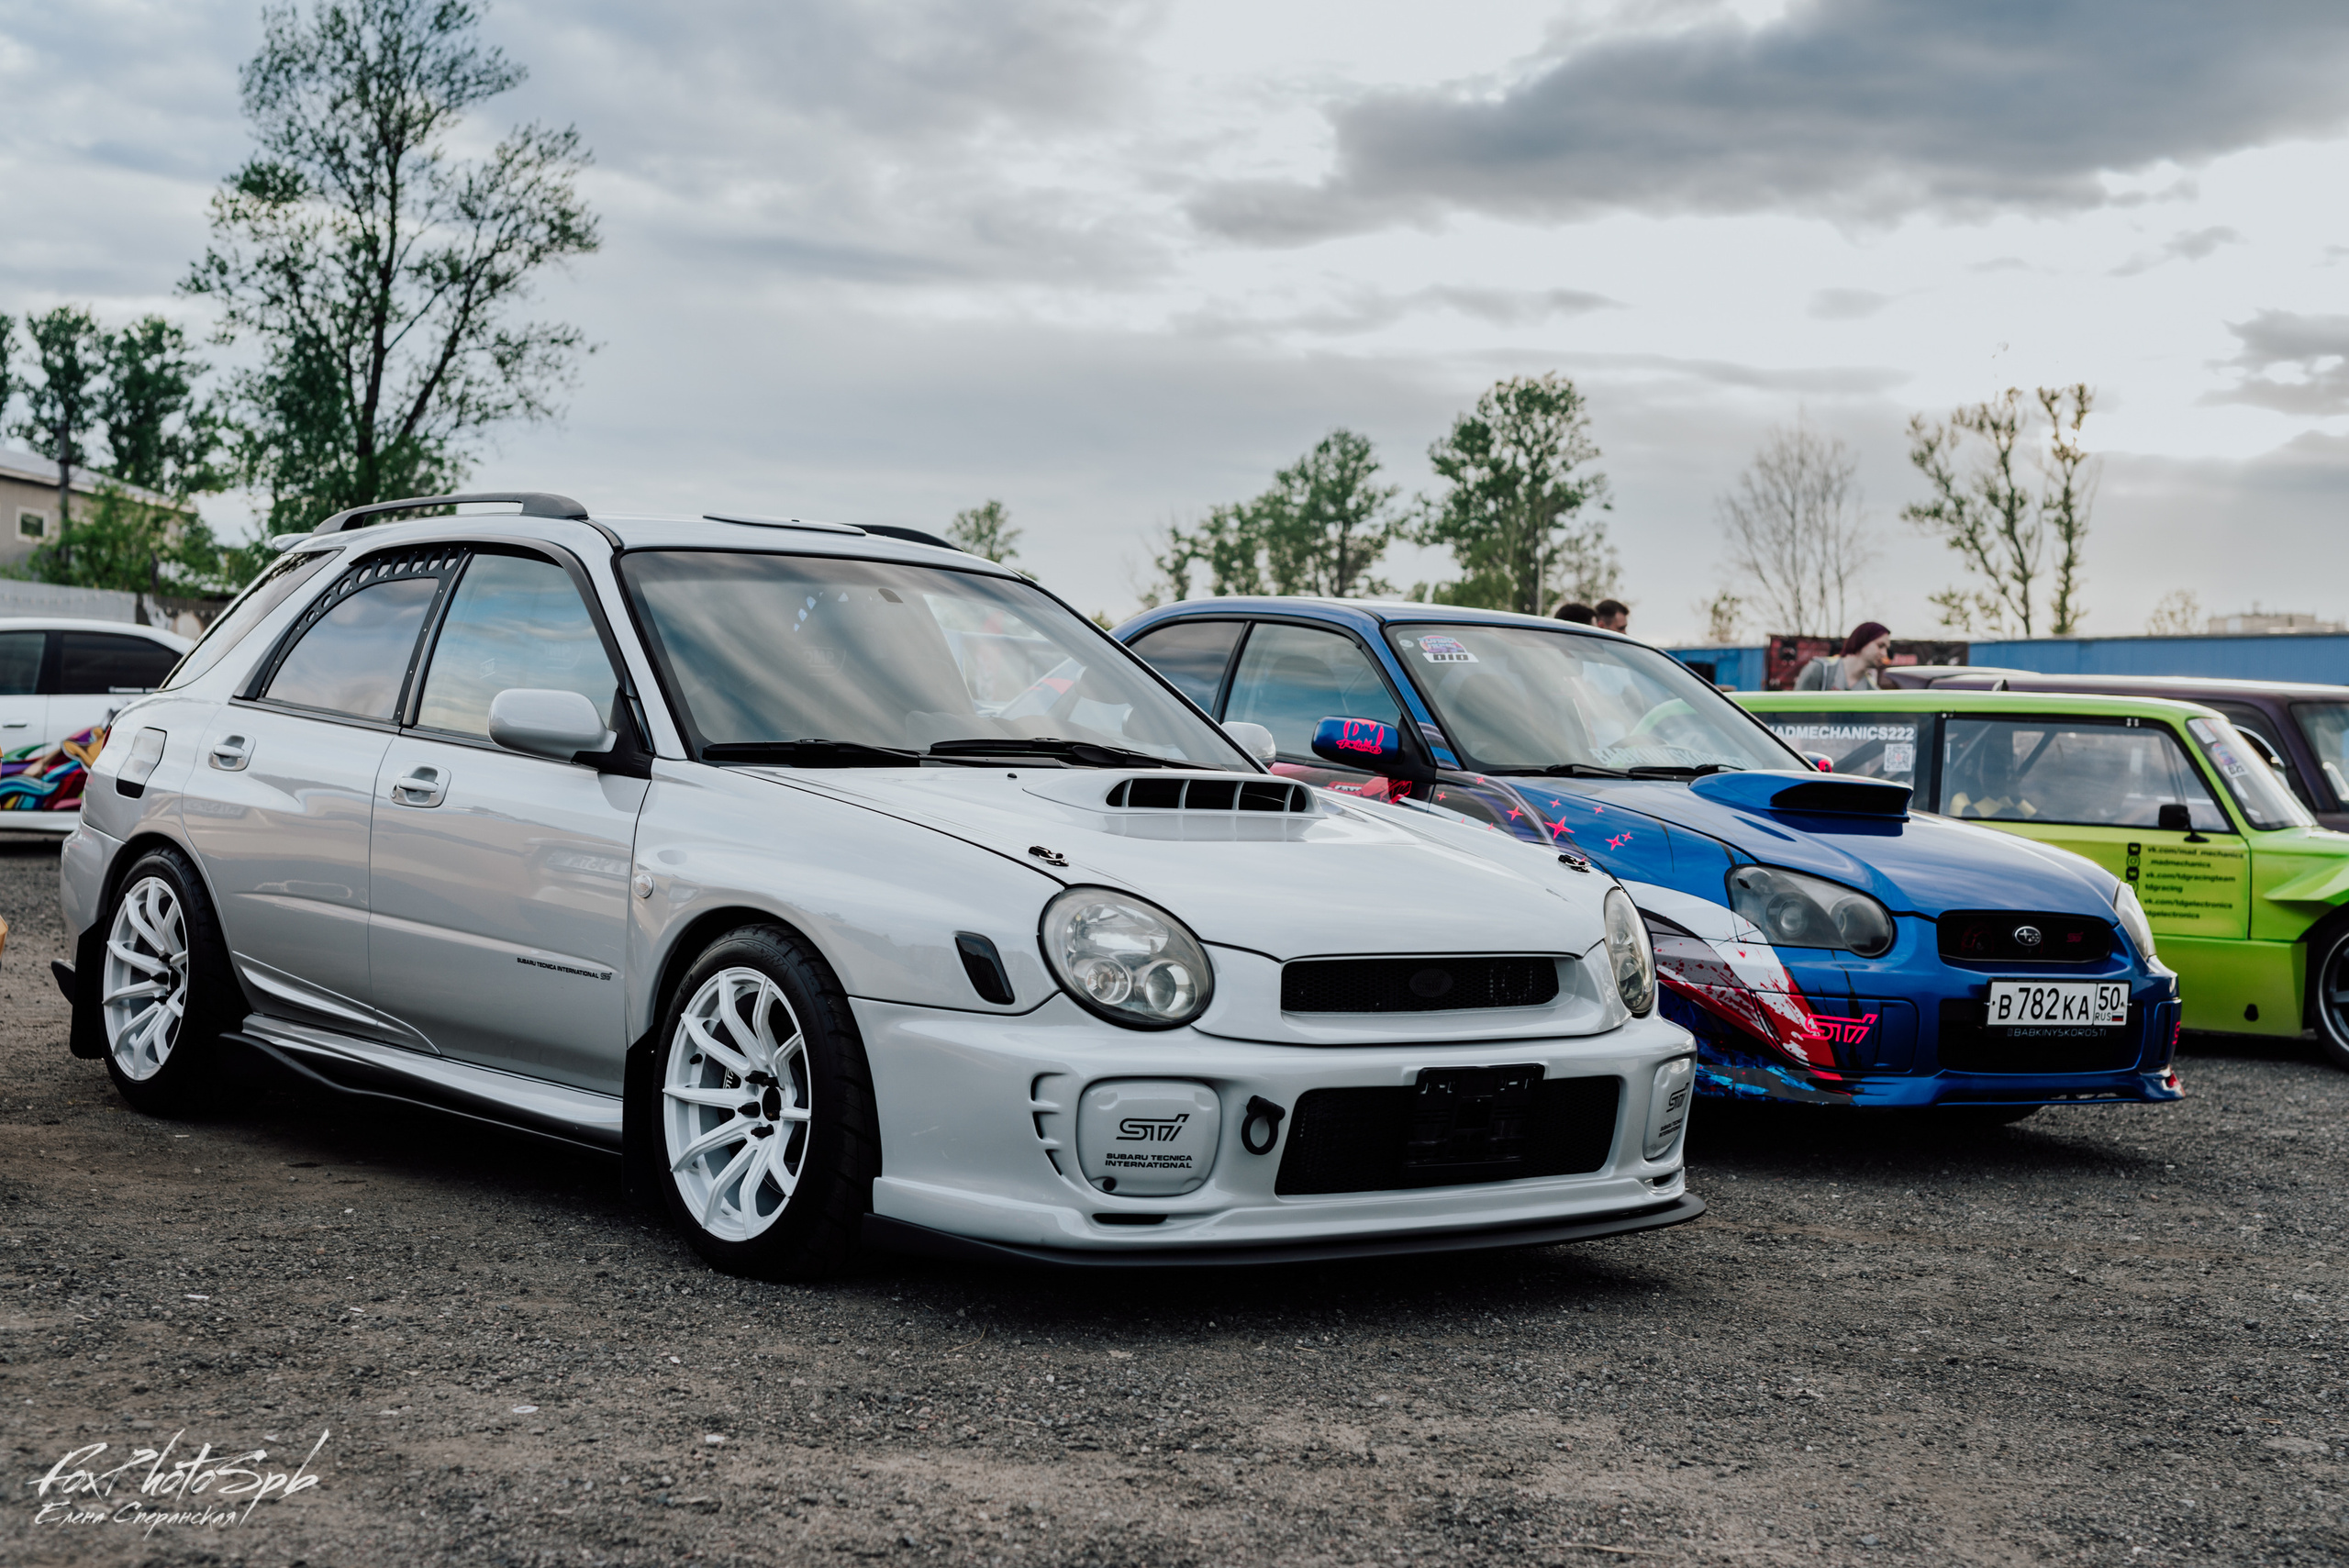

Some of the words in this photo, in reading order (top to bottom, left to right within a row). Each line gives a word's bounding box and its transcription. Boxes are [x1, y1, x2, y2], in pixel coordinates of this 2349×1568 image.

[517, 957, 537, 966] SUBARU
[537, 962, 556, 971] TECNICA
[557, 965, 599, 979] INTERNATIONAL
[2098, 986, 2121, 1010] 50
[2094, 1012, 2111, 1021] RUS
[1106, 1152, 1149, 1161] SUBARU
[1105, 1160, 1193, 1169] INTERNATIONAL
